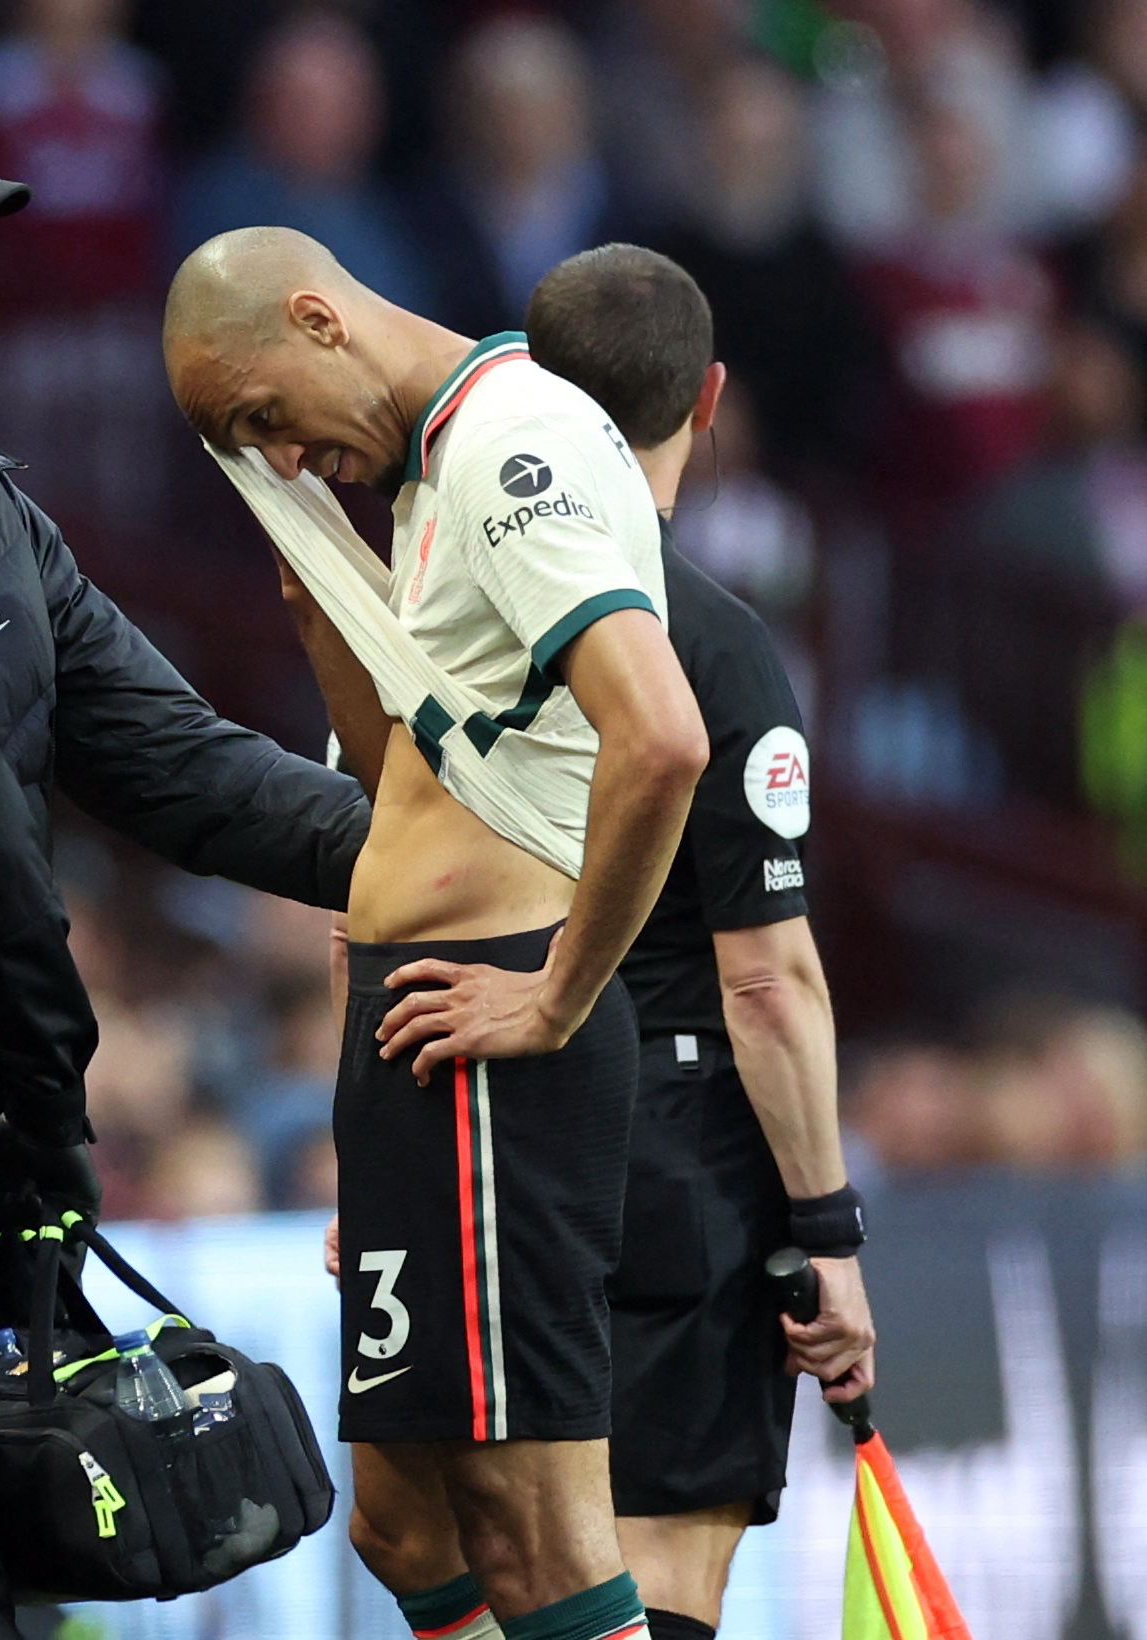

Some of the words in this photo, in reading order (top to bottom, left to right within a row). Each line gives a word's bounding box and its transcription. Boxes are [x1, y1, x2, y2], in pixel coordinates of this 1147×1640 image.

[482, 492, 595, 548] Expedia
[766, 753, 807, 789] EA
[357, 1250, 410, 1359] 3
